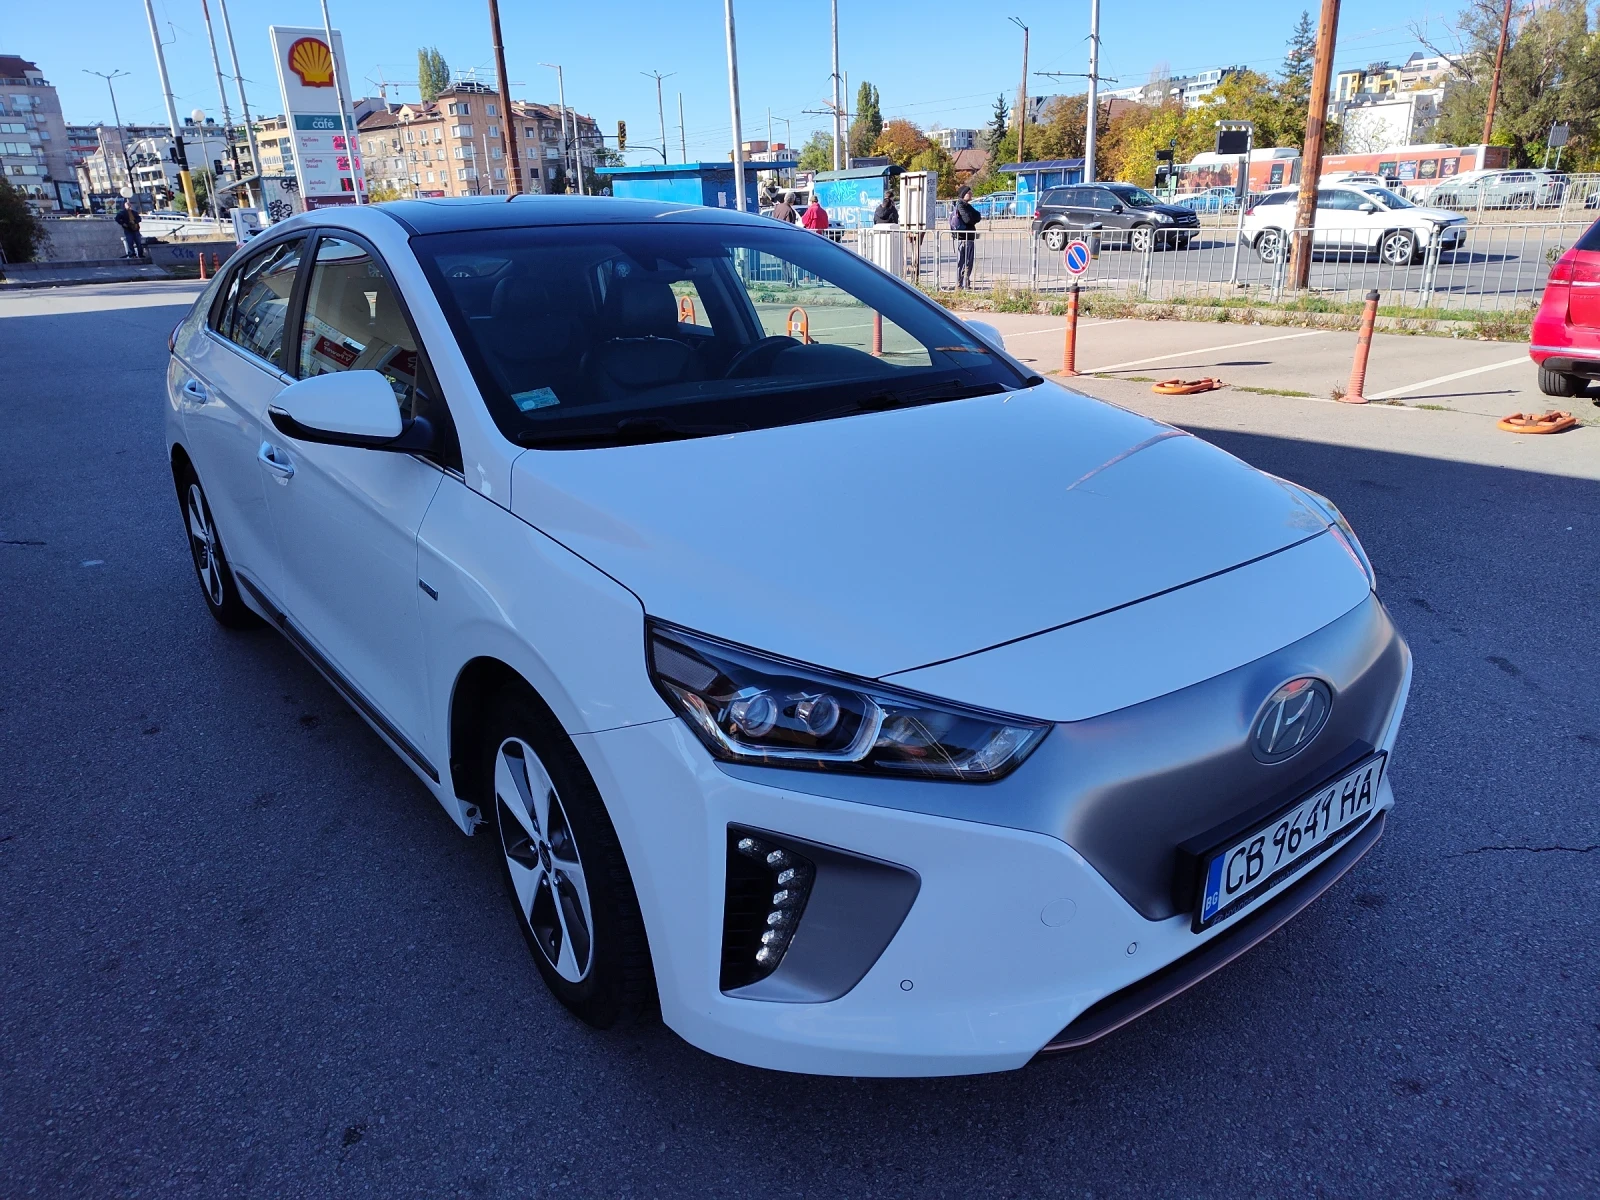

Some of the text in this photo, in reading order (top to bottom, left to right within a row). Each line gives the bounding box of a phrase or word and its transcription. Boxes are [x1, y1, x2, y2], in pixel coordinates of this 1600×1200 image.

[312, 118, 335, 129] café
[1226, 836, 1265, 895] CB
[1340, 768, 1373, 822] HA
[1206, 892, 1219, 911] BG
